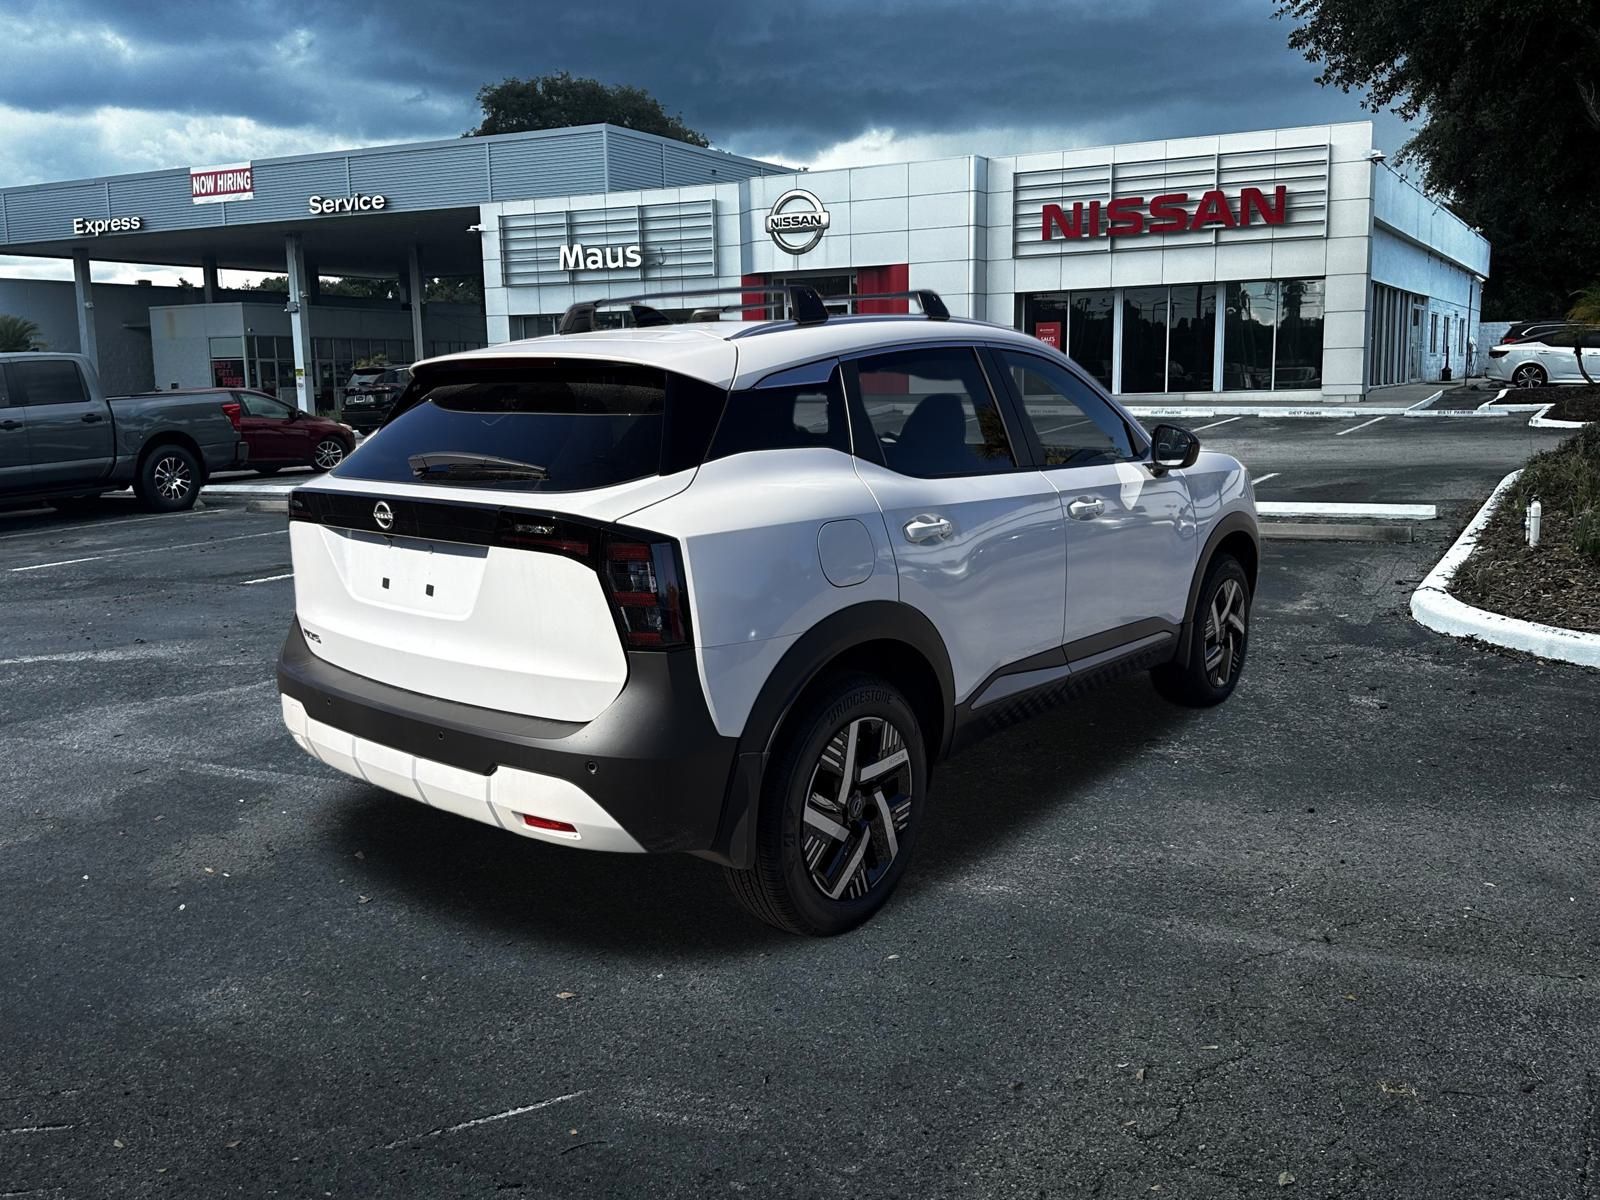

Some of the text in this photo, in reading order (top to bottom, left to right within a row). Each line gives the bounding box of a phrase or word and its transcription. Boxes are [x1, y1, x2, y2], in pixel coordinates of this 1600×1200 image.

[192, 171, 251, 195] NOW HIRING
[308, 194, 386, 215] Service
[1041, 185, 1288, 241] NISSAN
[72, 215, 141, 237] Express
[770, 214, 822, 228] NISSAN
[559, 243, 642, 271] Maus
[222, 376, 244, 387] FREE
